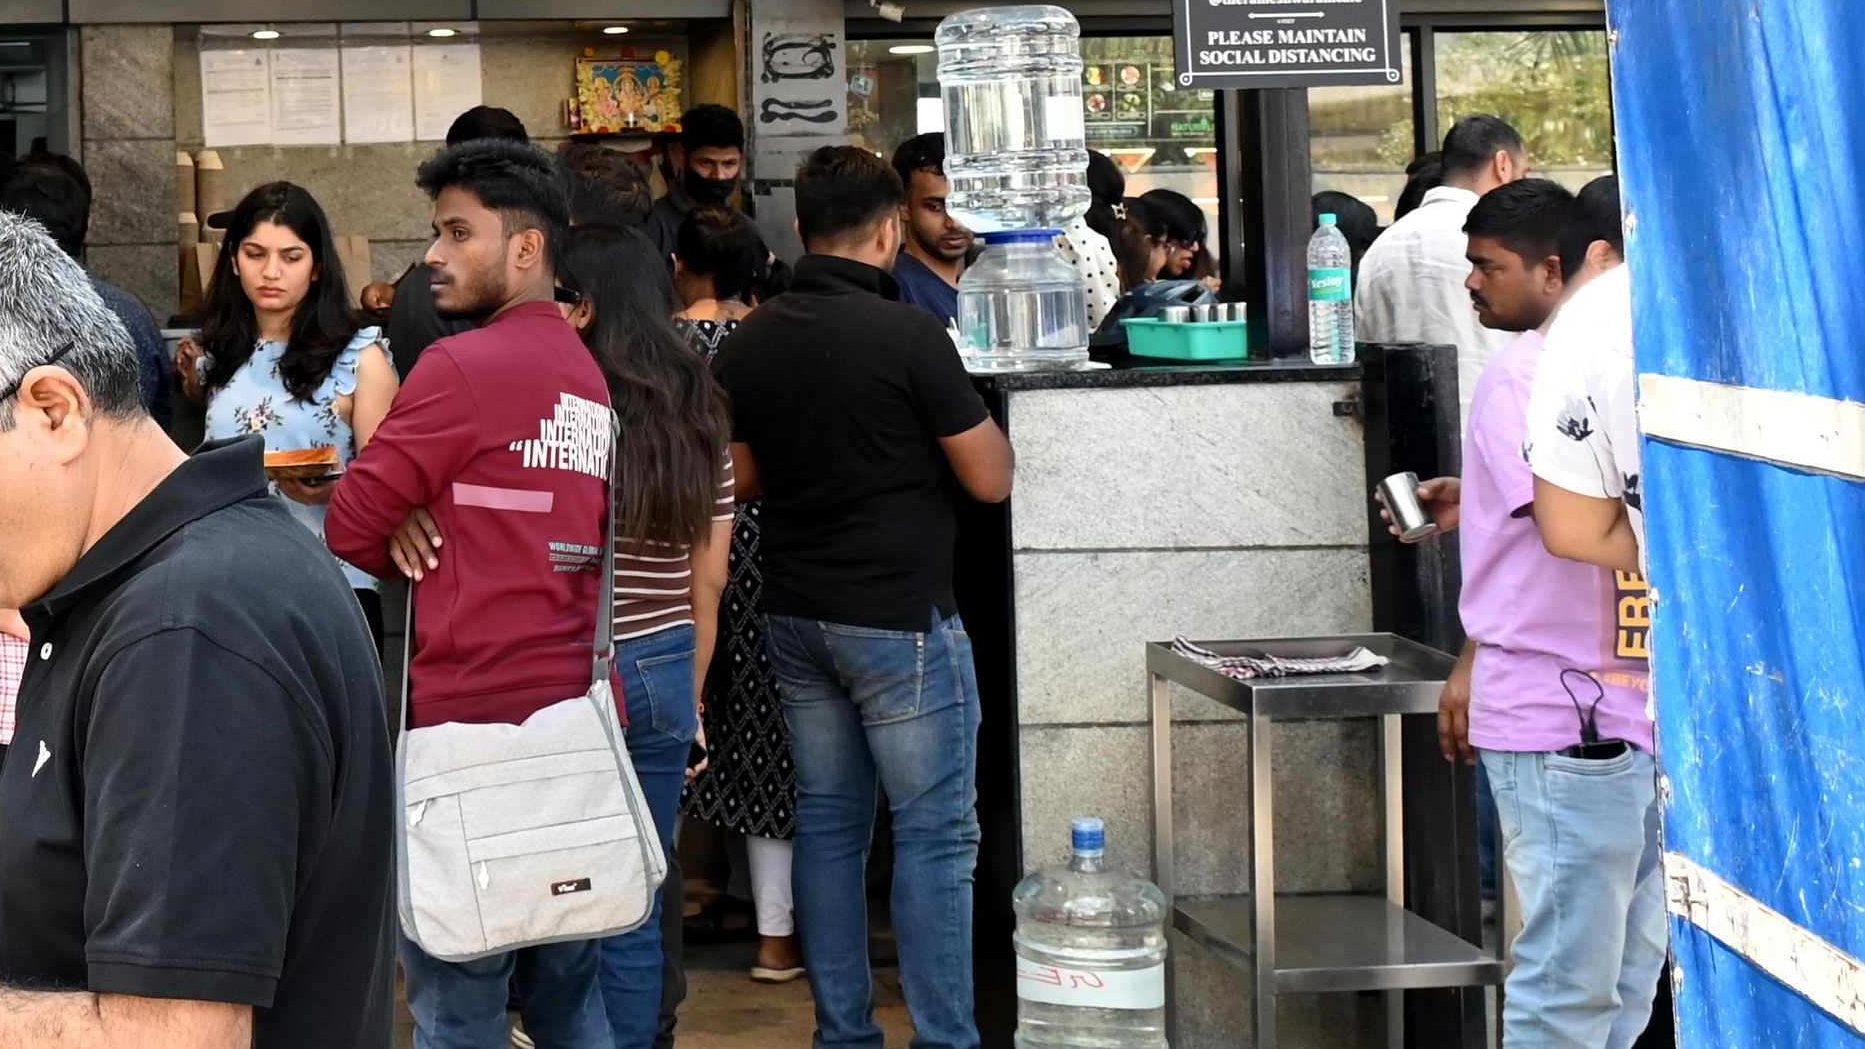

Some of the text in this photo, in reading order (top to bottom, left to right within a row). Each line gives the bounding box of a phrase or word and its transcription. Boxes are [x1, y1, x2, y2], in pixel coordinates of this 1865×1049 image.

[1207, 28, 1367, 46] PLEASE MAINTAIN
[1199, 47, 1376, 66] SOCIAL DISTANCING
